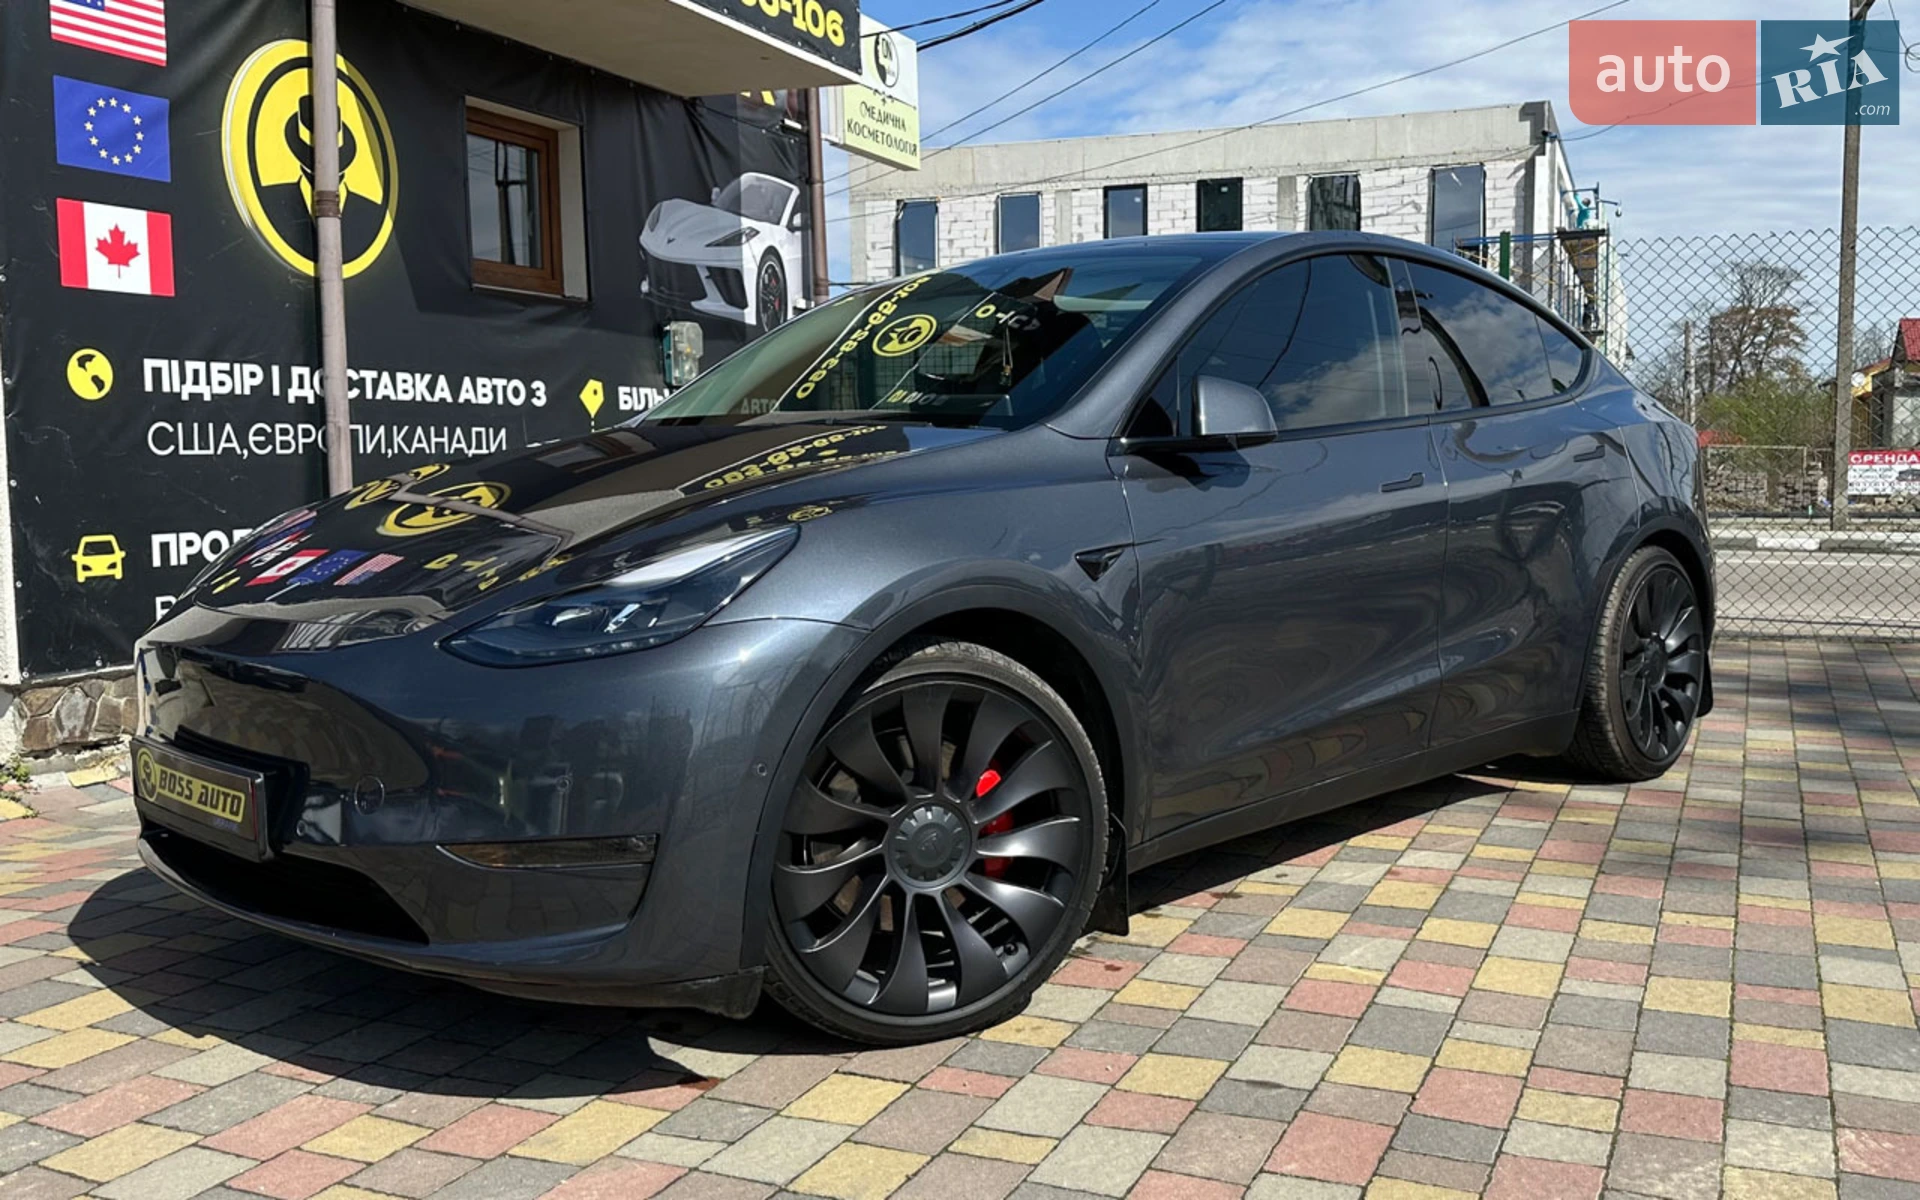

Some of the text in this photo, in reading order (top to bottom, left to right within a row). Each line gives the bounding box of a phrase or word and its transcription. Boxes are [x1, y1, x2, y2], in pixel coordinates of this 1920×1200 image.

[741, 0, 845, 47] -106
[847, 119, 918, 157] КОСМЕТОЛОГІЯ
[143, 358, 264, 401] ПІДБІР
[458, 376, 526, 406] АВТО
[159, 768, 193, 800] BOSS
